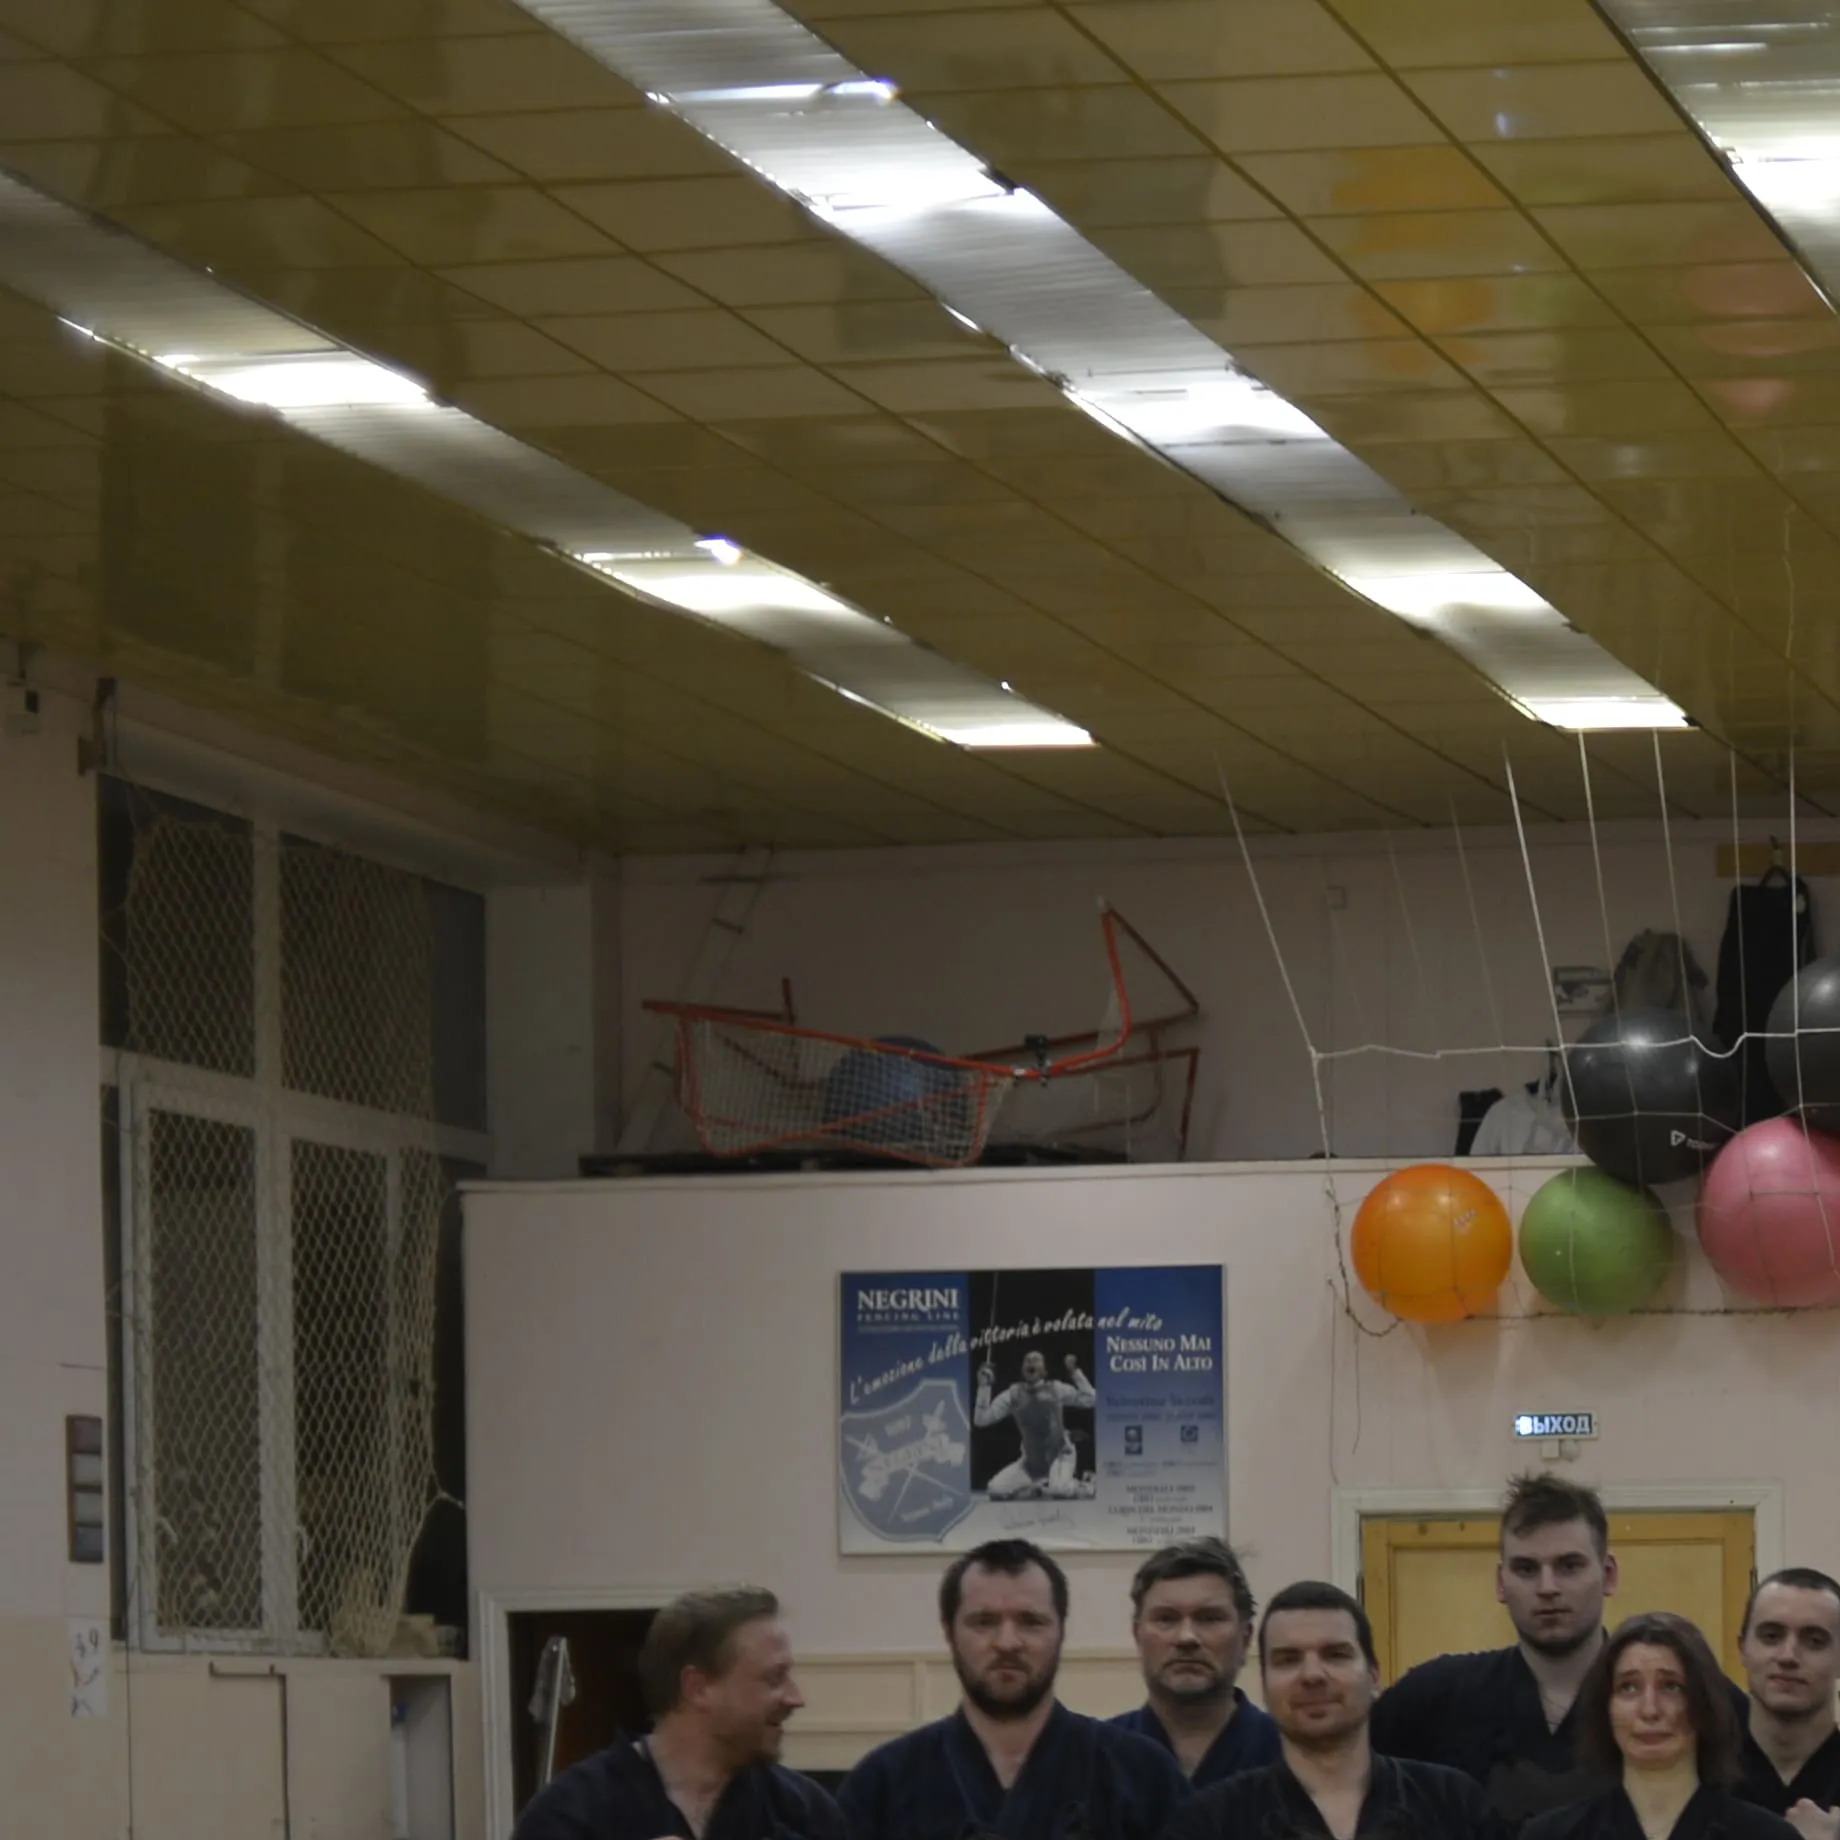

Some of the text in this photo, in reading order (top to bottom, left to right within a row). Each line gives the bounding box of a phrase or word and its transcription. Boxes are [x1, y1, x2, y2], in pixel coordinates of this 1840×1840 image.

[857, 1288, 960, 1312] NEGRINI
[928, 1331, 969, 1365] della
[1106, 1333, 1212, 1354] NESSUNO MAI
[1173, 1352, 1213, 1372] ALTO
[1519, 1415, 1591, 1436] ВЫХОД
